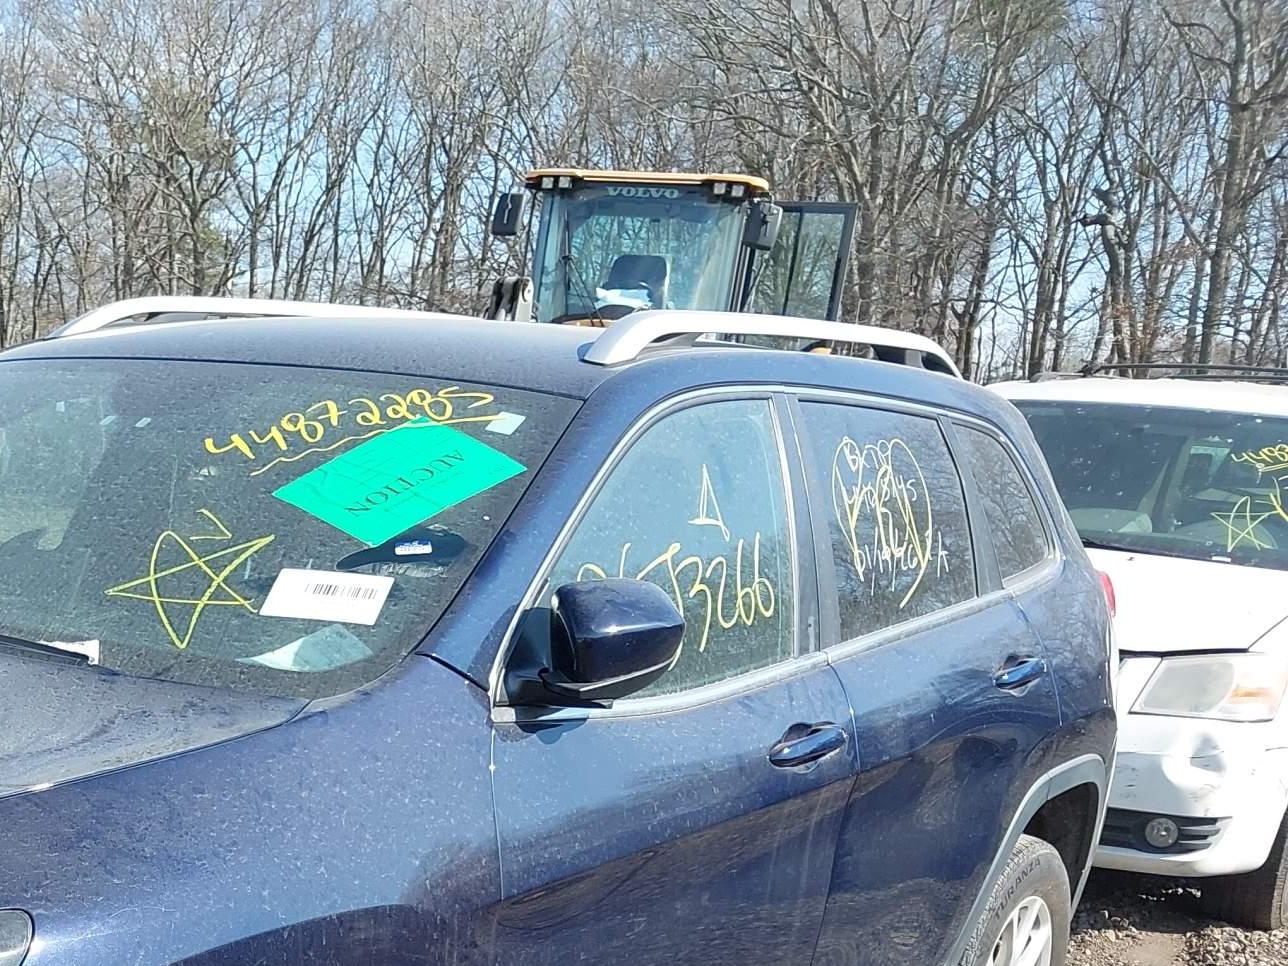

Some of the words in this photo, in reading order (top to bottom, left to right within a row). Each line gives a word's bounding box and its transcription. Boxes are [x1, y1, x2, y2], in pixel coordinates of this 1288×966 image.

[607, 186, 680, 199] VOLVO
[204, 386, 495, 460] 44872285
[343, 448, 466, 518] AUCTION
[991, 858, 1041, 920] TURANZA
